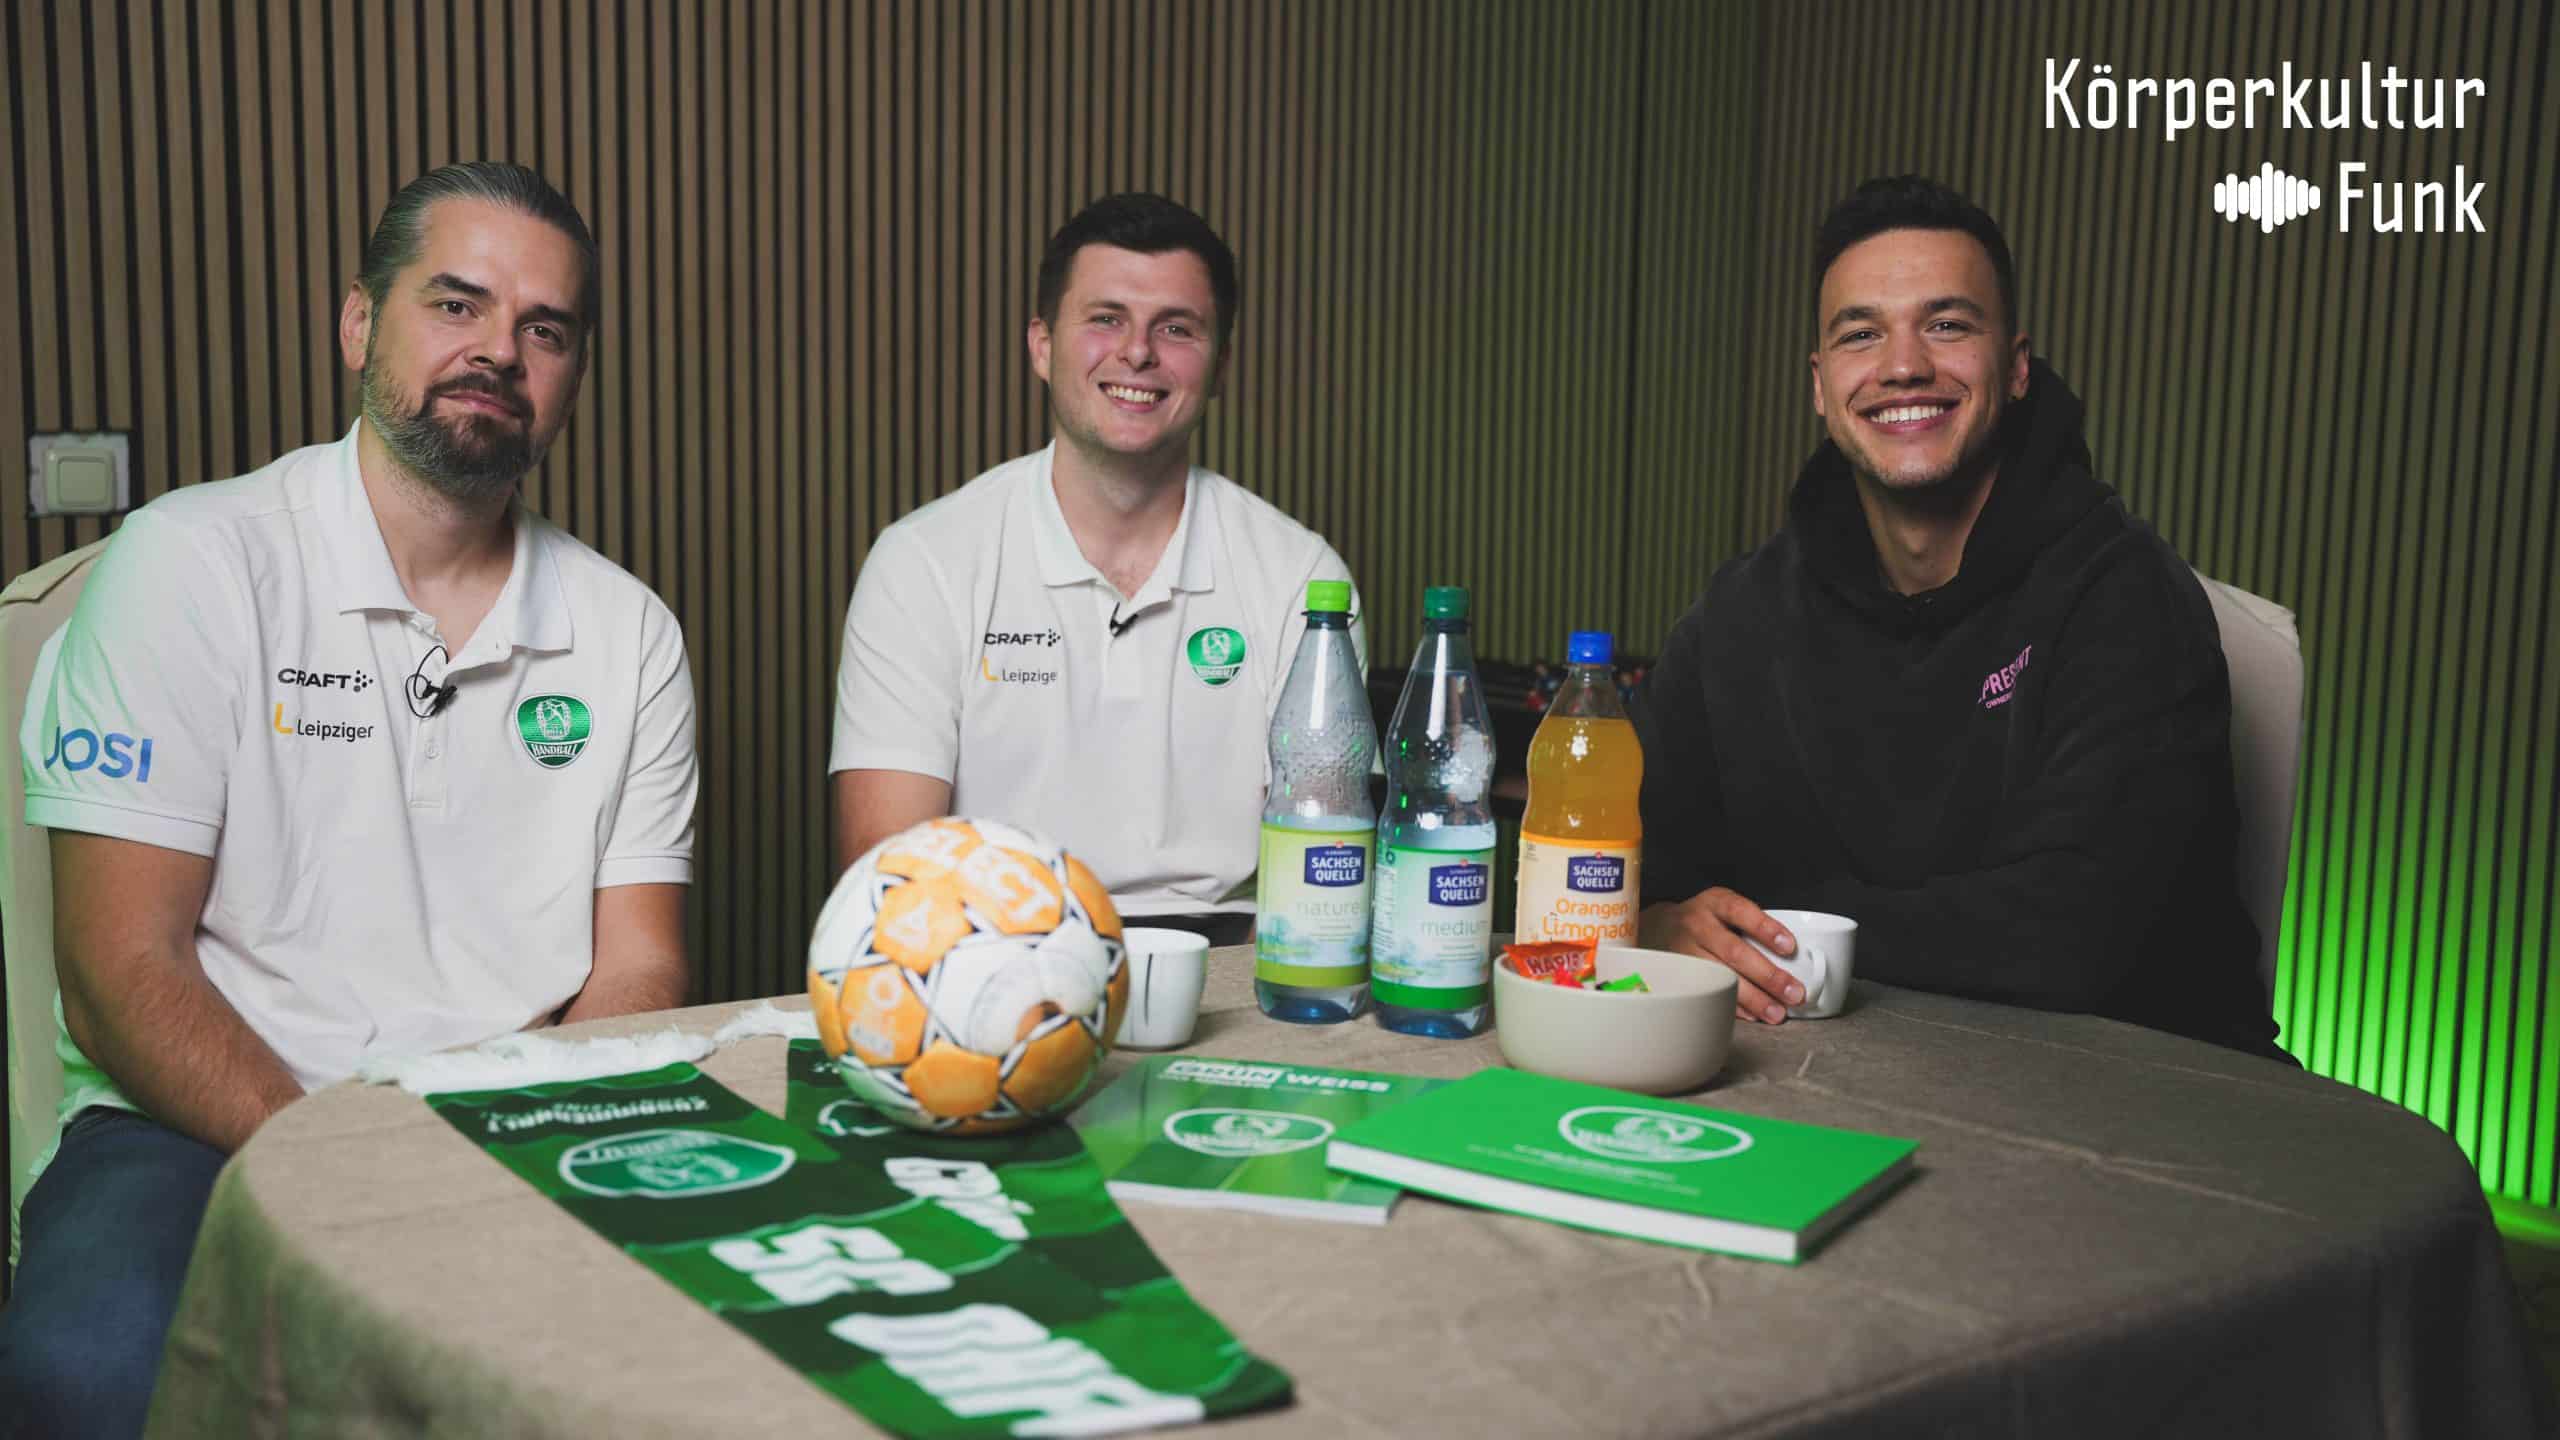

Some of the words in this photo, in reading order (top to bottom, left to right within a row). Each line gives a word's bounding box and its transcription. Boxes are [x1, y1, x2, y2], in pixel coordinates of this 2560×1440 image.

[983, 632, 1046, 646] CRAFT
[277, 667, 352, 689] CRAFT
[1002, 668, 1058, 686] Leipzige
[297, 719, 375, 743] Leipziger
[44, 726, 153, 783] JOSI
[1311, 856, 1361, 869] SACHSEN
[1315, 869, 1358, 883] QUELLE
[1574, 865, 1620, 877] SACHSEN
[1436, 876, 1485, 889] SACHSEN
[1576, 877, 1617, 889] QUELLE
[1440, 888, 1481, 901] QUELLE
[1555, 897, 1630, 918] Orangen
[1285, 1073, 1391, 1093] WEISS
